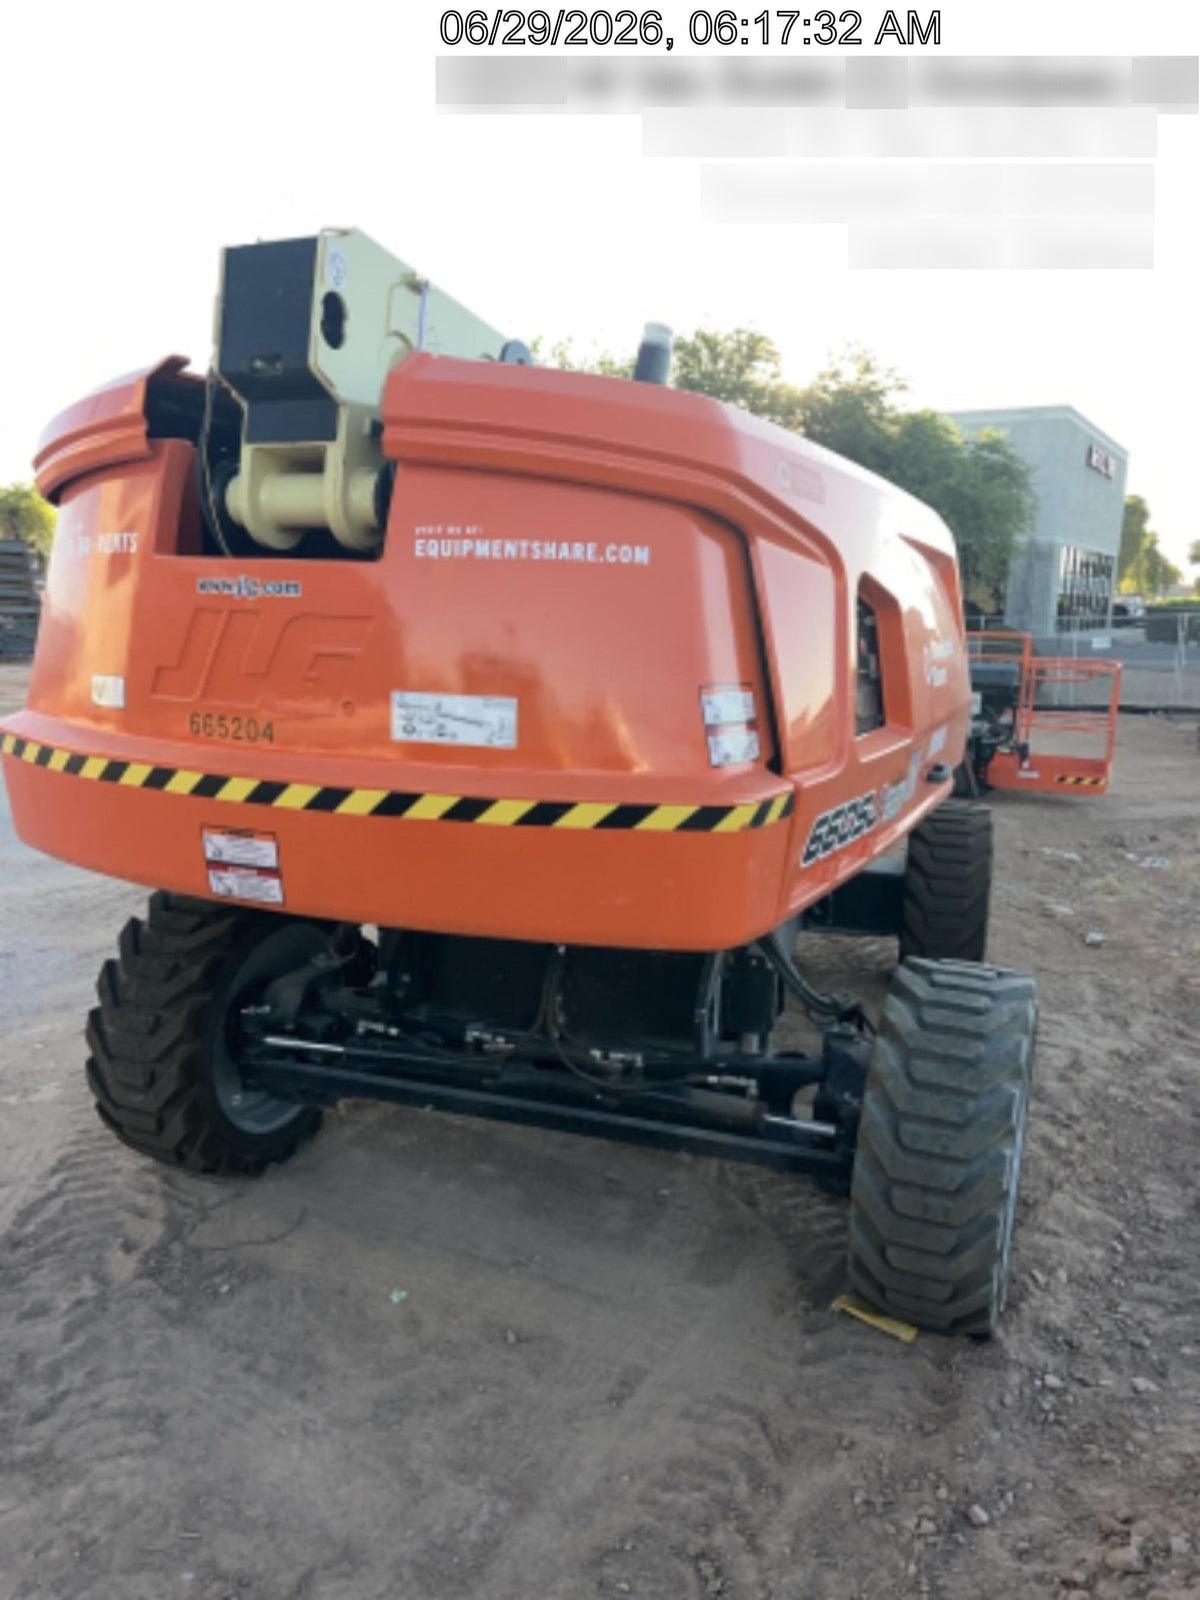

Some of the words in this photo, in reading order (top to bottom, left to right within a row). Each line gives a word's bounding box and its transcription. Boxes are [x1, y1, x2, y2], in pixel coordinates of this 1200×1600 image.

[413, 538, 651, 565] EQUIPMENTSHARE.COM
[197, 575, 302, 600] www.jlg.com
[150, 607, 376, 713] JLG
[189, 711, 275, 744] 665204
